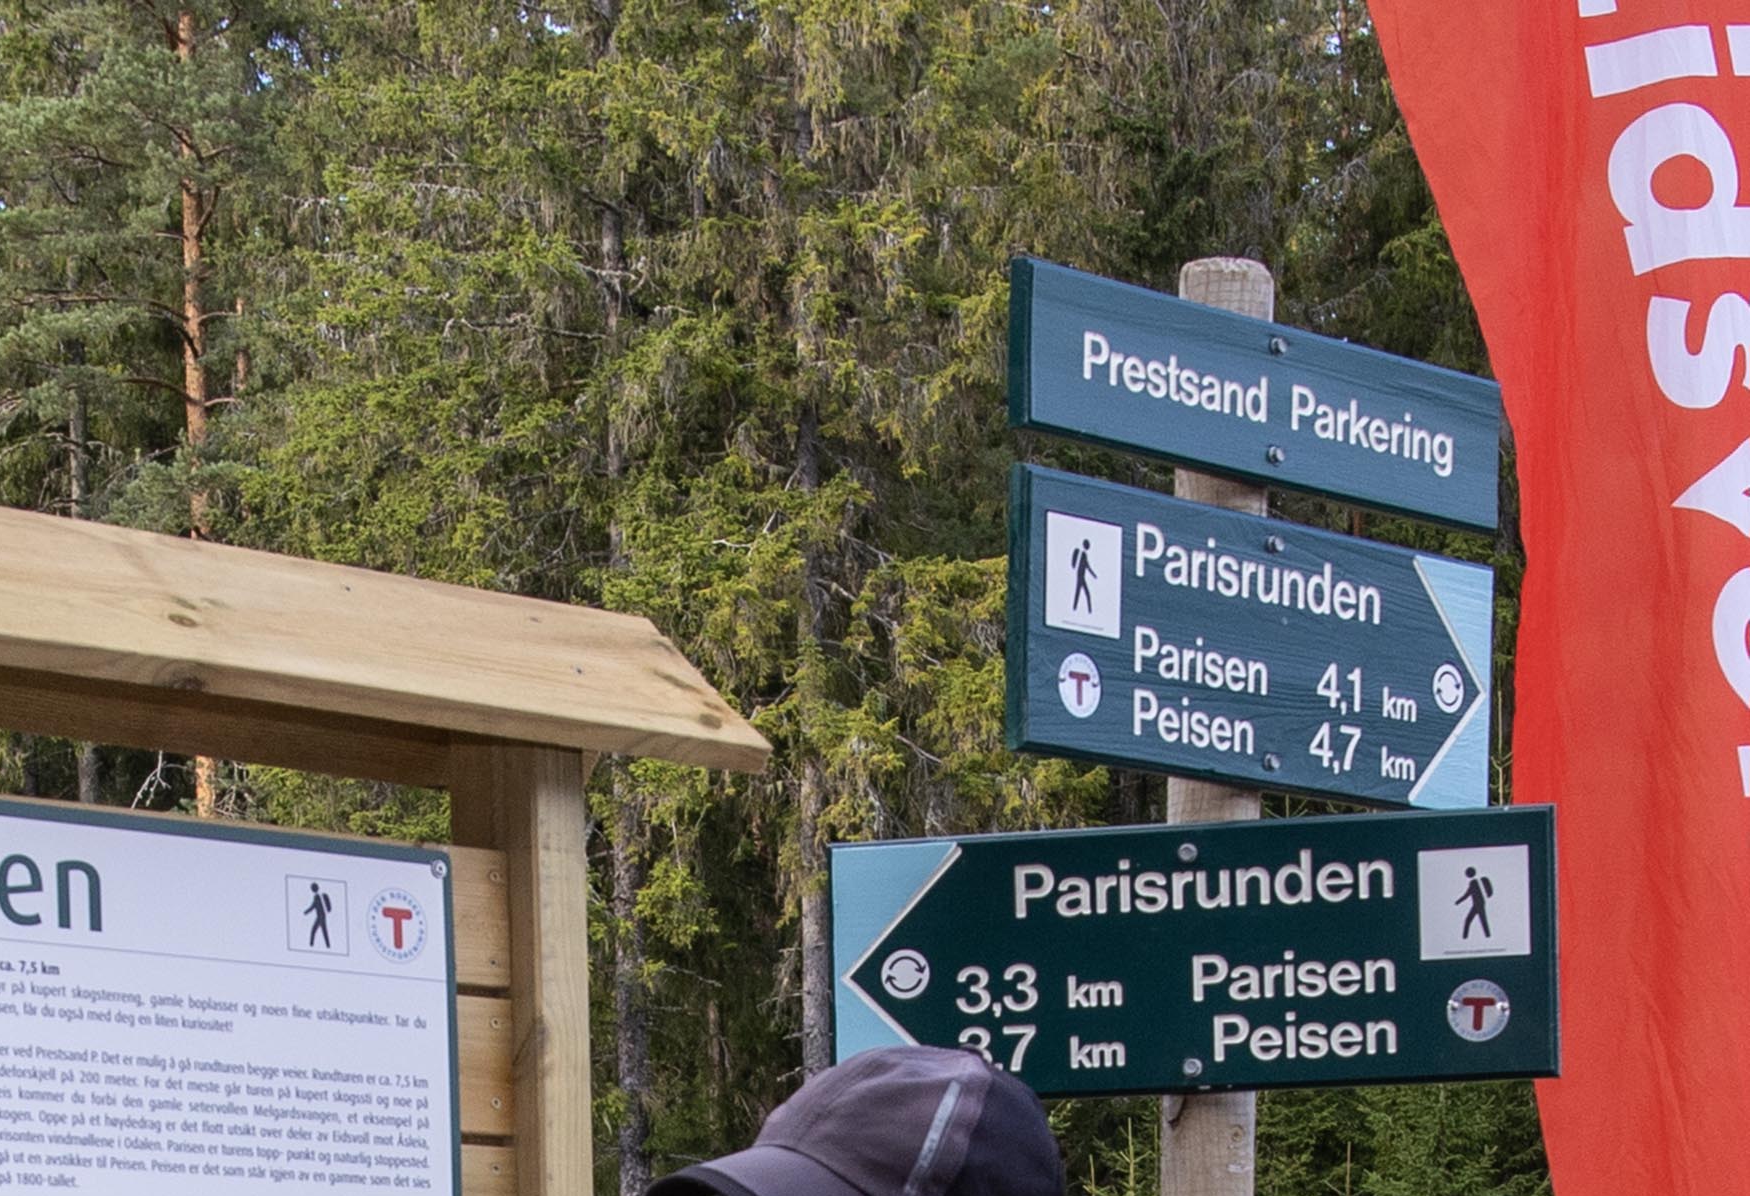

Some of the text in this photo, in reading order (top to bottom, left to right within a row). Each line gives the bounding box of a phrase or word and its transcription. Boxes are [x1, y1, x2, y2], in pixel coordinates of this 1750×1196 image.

[1082, 330, 1455, 477] Prestsand Parkering
[1134, 522, 1382, 625] Parisrunden
[1133, 626, 1417, 724] Parisen 4,1 km
[1133, 688, 1416, 782] Peisen 4,7 km
[1013, 849, 1395, 919] Parisrunden
[19, 960, 37, 976] 7,5
[40, 962, 60, 975] km
[955, 951, 1396, 1019] 3,3 km Parisen
[11, 979, 25, 995] på
[30, 982, 66, 999] kupert
[71, 986, 144, 1006] skogsterreng,
[150, 993, 183, 1009] gamle
[188, 996, 238, 1014] boplasser
[243, 1004, 256, 1016] og
[261, 1005, 287, 1016] noen
[292, 1005, 311, 1018] fine
[316, 1008, 388, 1027] utsiktspunkter.
[395, 1015, 409, 1027] Tar
[413, 1016, 426, 1028] du
[23, 1002, 37, 1016] får
[40, 1005, 55, 1017] du
[58, 1005, 83, 1022] også
[87, 1009, 111, 1022] med
[114, 1011, 135, 1026] deg
[137, 1016, 151, 1025] en
[154, 1014, 178, 1027] liten
[181, 1017, 233, 1032] kuriositet!
[13, 1045, 32, 1058] ved
[35, 1047, 88, 1062] Prestsand
[90, 1051, 98, 1063] P.
[101, 1052, 120, 1064] Det
[122, 1056, 132, 1065] er
[136, 1054, 166, 1070] mulig
[169, 1056, 175, 1069] å
[178, 1057, 191, 1072] gå
[193, 1059, 244, 1074] rundturen
[247, 1063, 279, 1079] begge
[282, 1066, 307, 1078] veier.
[311, 1068, 363, 1083] Rundturen
[366, 1075, 375, 1084] er
[378, 1076, 391, 1085] ca.
[395, 1074, 410, 1088] 7,5
[412, 1076, 428, 1088] km
[1070, 1036, 1126, 1070] km
[1212, 1011, 1398, 1062] Peisen
[18, 1088, 64, 1103] kommer
[71, 1092, 85, 1104] du
[91, 1093, 116, 1106] forbi
[122, 1095, 143, 1108] den
[149, 1097, 182, 1113] gamle
[188, 1100, 247, 1115] setervollen
[253, 1104, 340, 1124] Melgardsvangen,
[347, 1112, 357, 1122] et
[363, 1112, 412, 1128] eksempel
[417, 1115, 429, 1130] på
